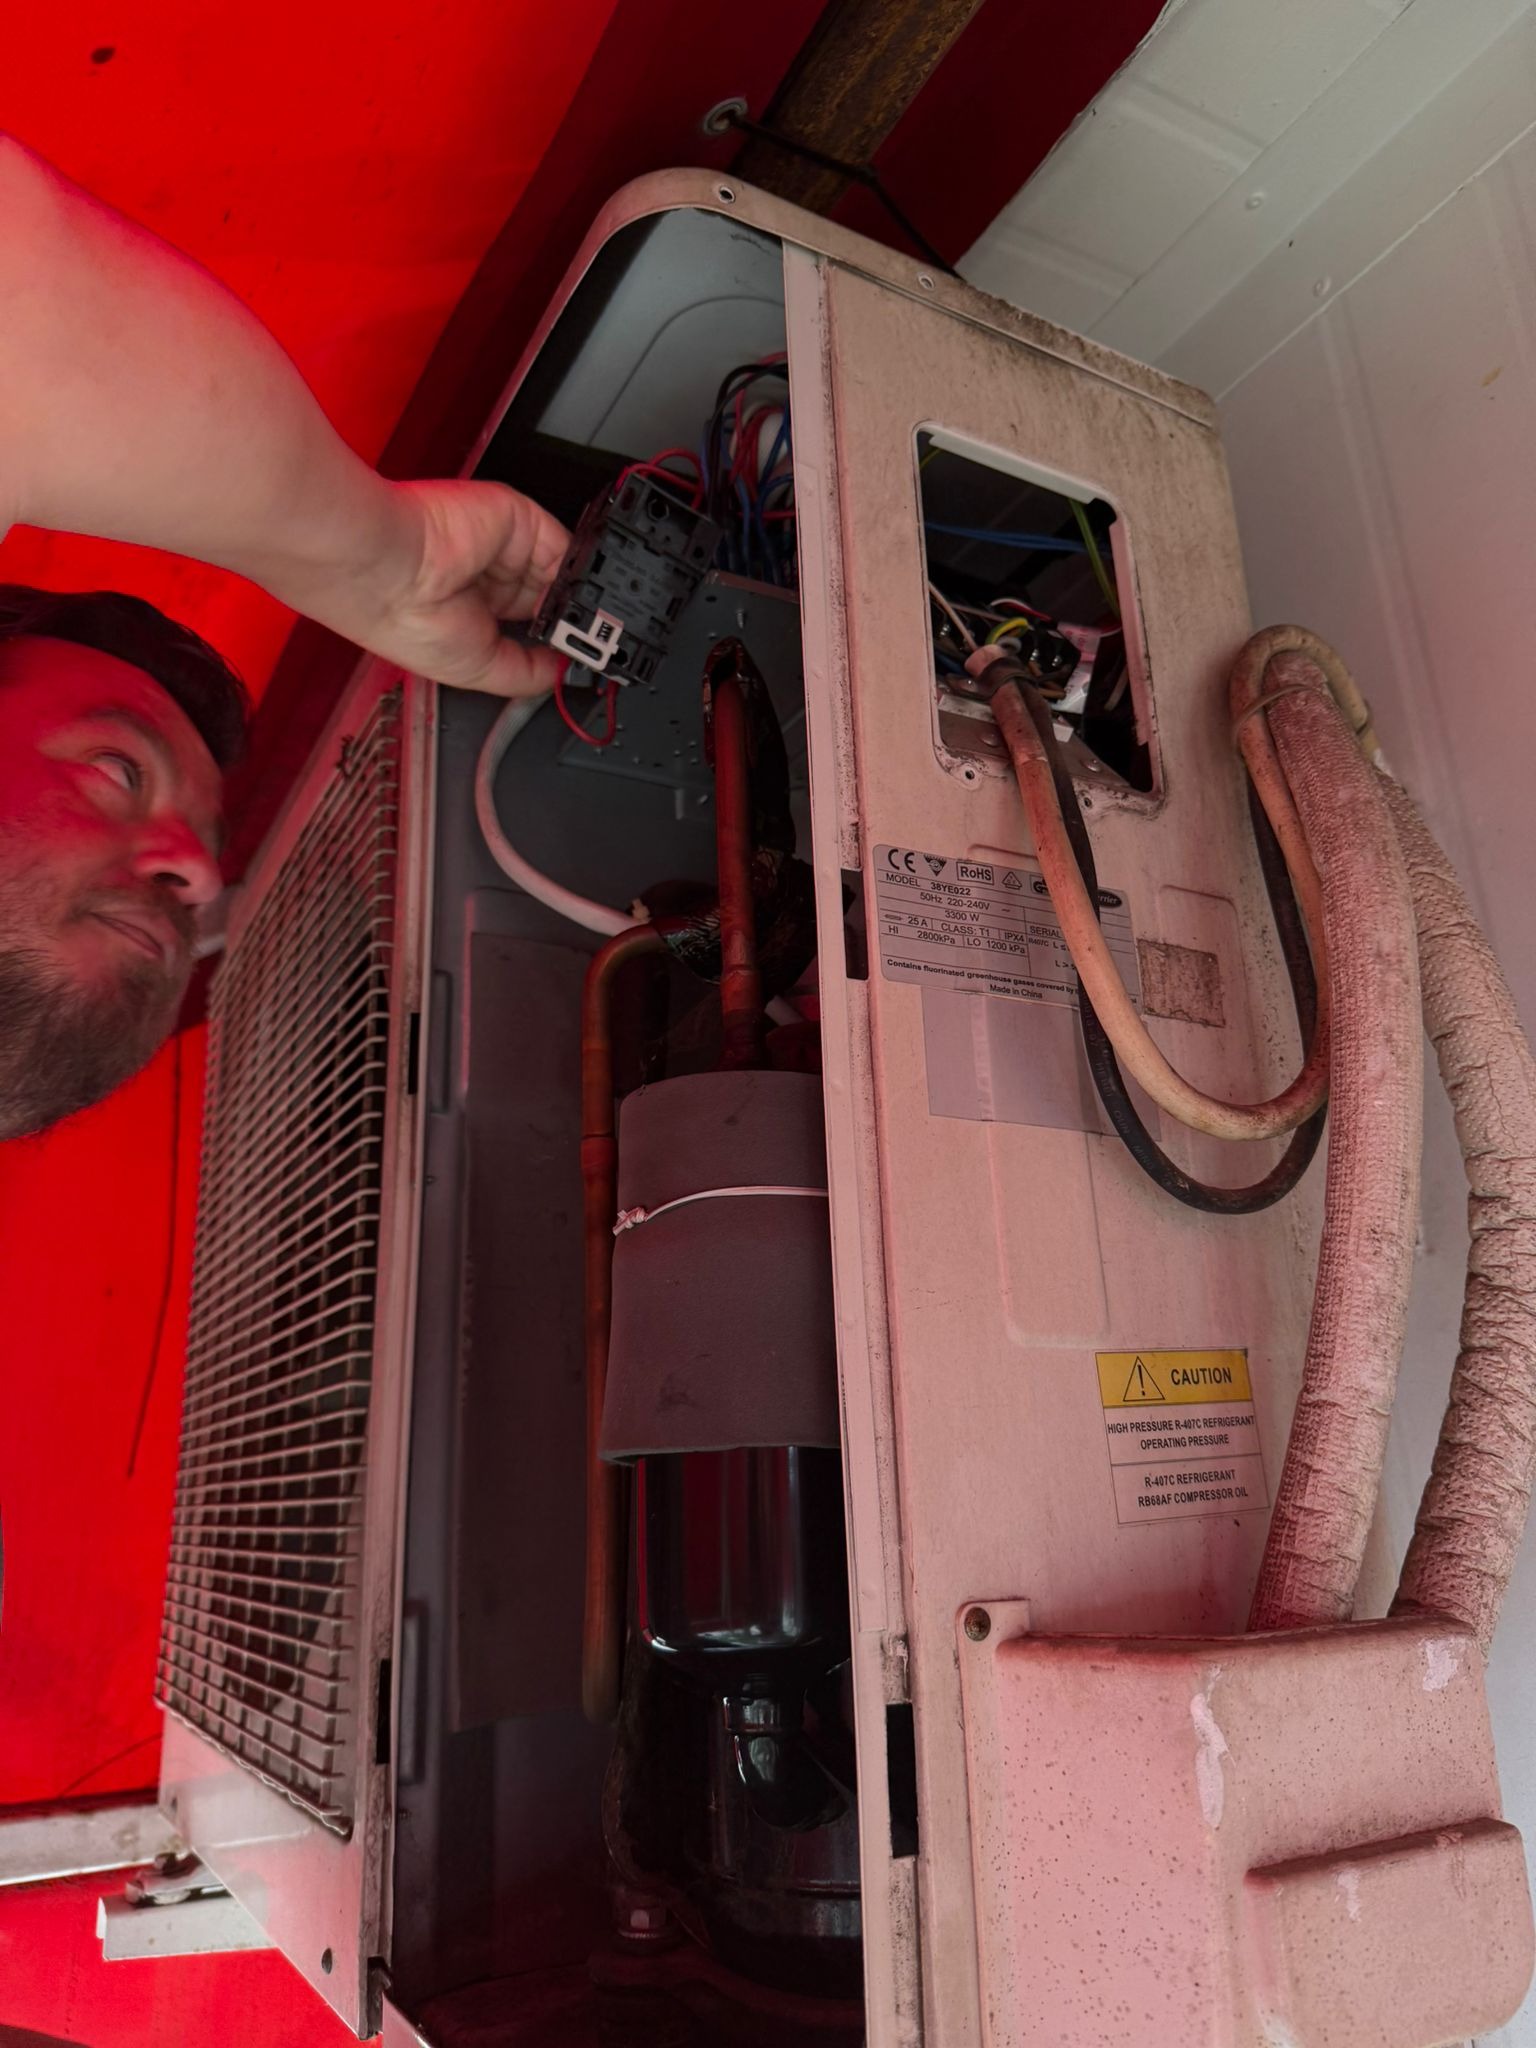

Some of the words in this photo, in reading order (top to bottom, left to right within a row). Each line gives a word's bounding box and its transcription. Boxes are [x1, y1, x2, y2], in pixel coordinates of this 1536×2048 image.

[959, 865, 992, 881] RoHS
[886, 873, 921, 887] MODEL
[930, 882, 971, 896] 38YE022
[920, 892, 943, 903] 50Hz
[947, 897, 990, 911] 220-240V
[944, 910, 967, 921] 3300
[969, 913, 980, 922] W
[888, 925, 899, 934] HI
[917, 930, 956, 945] 2800kPa
[941, 923, 977, 935] CLASS:
[980, 927, 990, 936] T1
[1004, 931, 1025, 942] IPX4
[1030, 926, 1061, 938] SERIAL
[967, 938, 981, 947] LO
[986, 940, 1007, 952] 1200
[1009, 943, 1026, 954] kPa
[887, 959, 921, 971] Contains
[923, 965, 965, 977] fluorinated
[966, 971, 1011, 984] greenhouse
[1013, 978, 1034, 987] gases
[1036, 981, 1064, 991] covered
[1066, 986, 1074, 994] by
[989, 984, 1010, 994] Made
[1012, 987, 1020, 995] in
[1021, 988, 1043, 999] China
[1170, 1367, 1232, 1386] CAUTION
[1107, 1422, 1129, 1434] HIGH
[1130, 1419, 1173, 1433] PRESSURE
[1175, 1417, 1201, 1430] R-407C
[1203, 1415, 1255, 1428] REFRIGERANT
[1140, 1436, 1187, 1450] OPERATING
[1188, 1433, 1230, 1447] PRESSURE
[1144, 1475, 1175, 1487] R-407C
[1176, 1469, 1236, 1485] REFRIGERANT
[1138, 1494, 1172, 1508] RB68AF
[1174, 1489, 1234, 1504] COMPRESSOR
[1235, 1486, 1249, 1498] OIL
